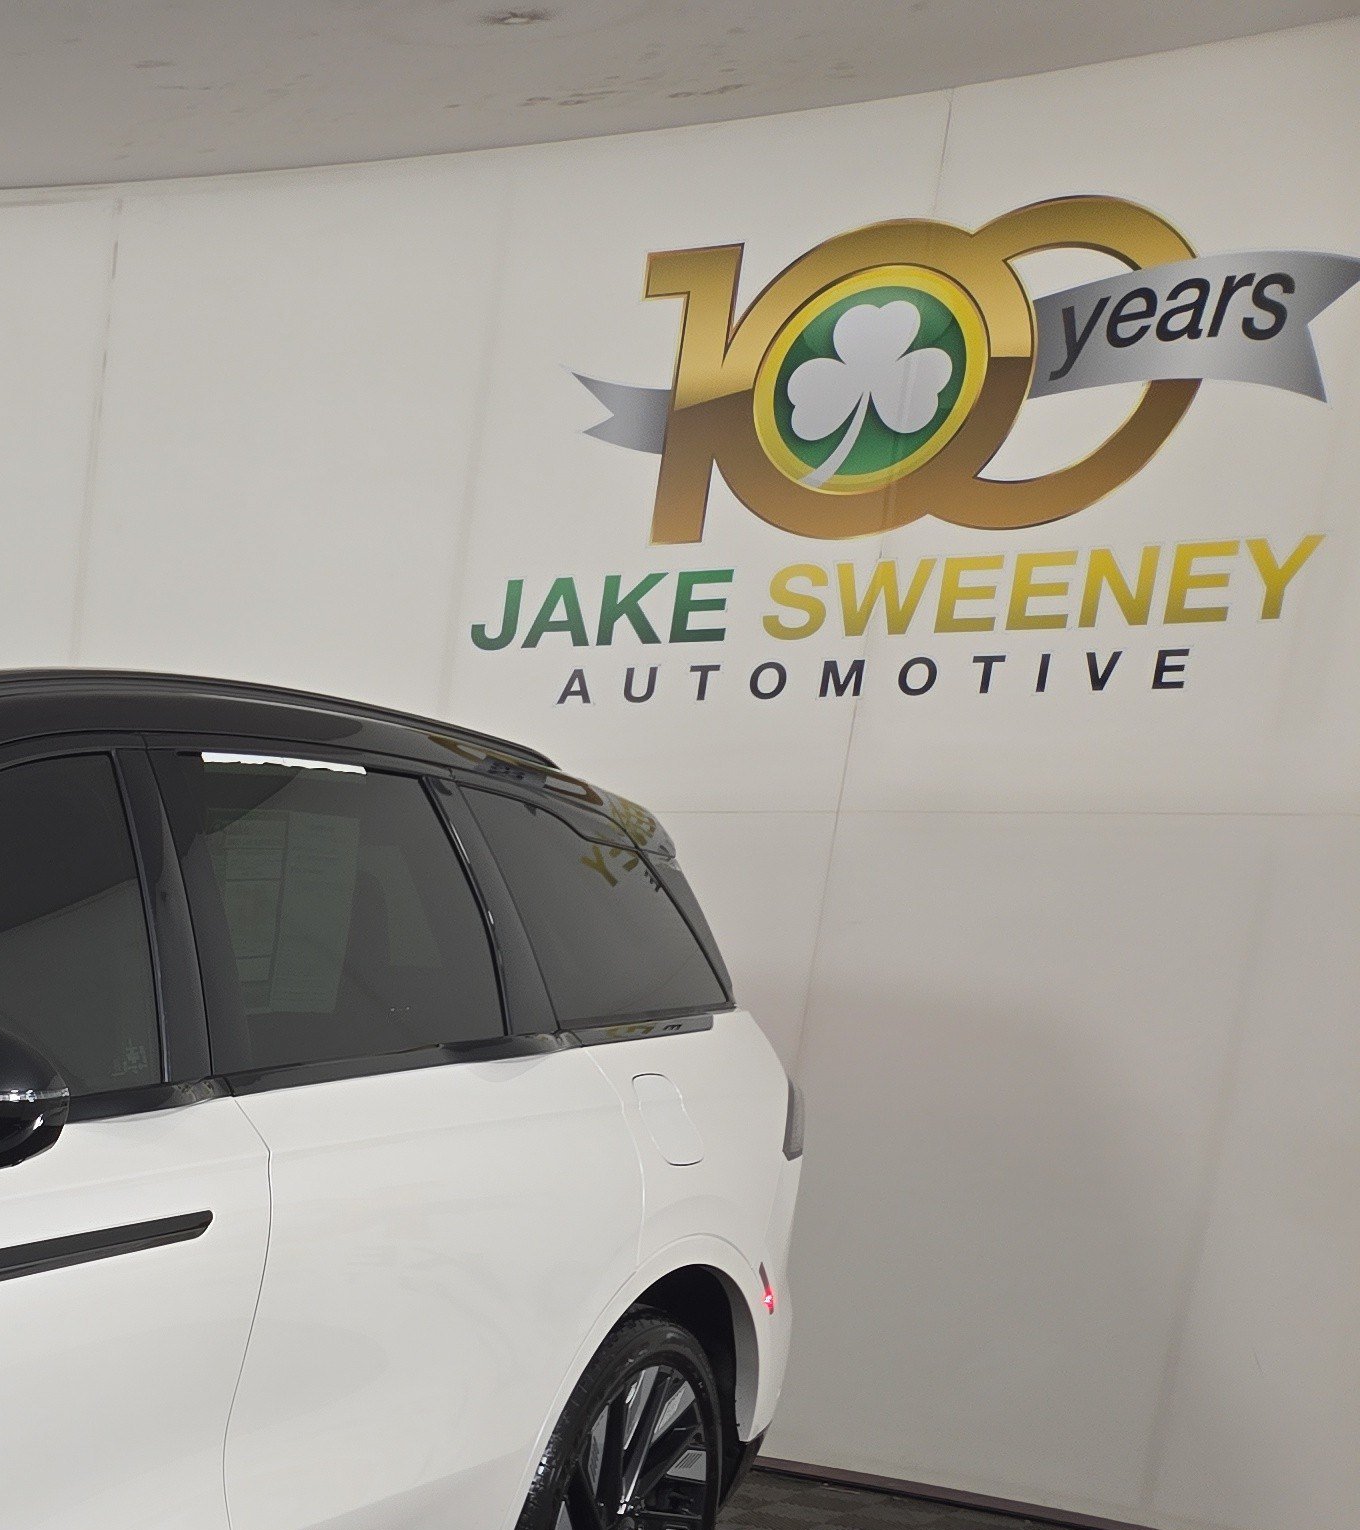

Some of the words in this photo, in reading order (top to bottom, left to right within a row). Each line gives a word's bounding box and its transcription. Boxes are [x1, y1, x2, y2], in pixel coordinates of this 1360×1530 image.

[640, 194, 1203, 547] 100
[1048, 269, 1297, 383] years
[471, 568, 735, 652] JAKE
[761, 534, 1326, 642] SWEENEY
[556, 648, 1190, 706] AUTOMOTIVE
